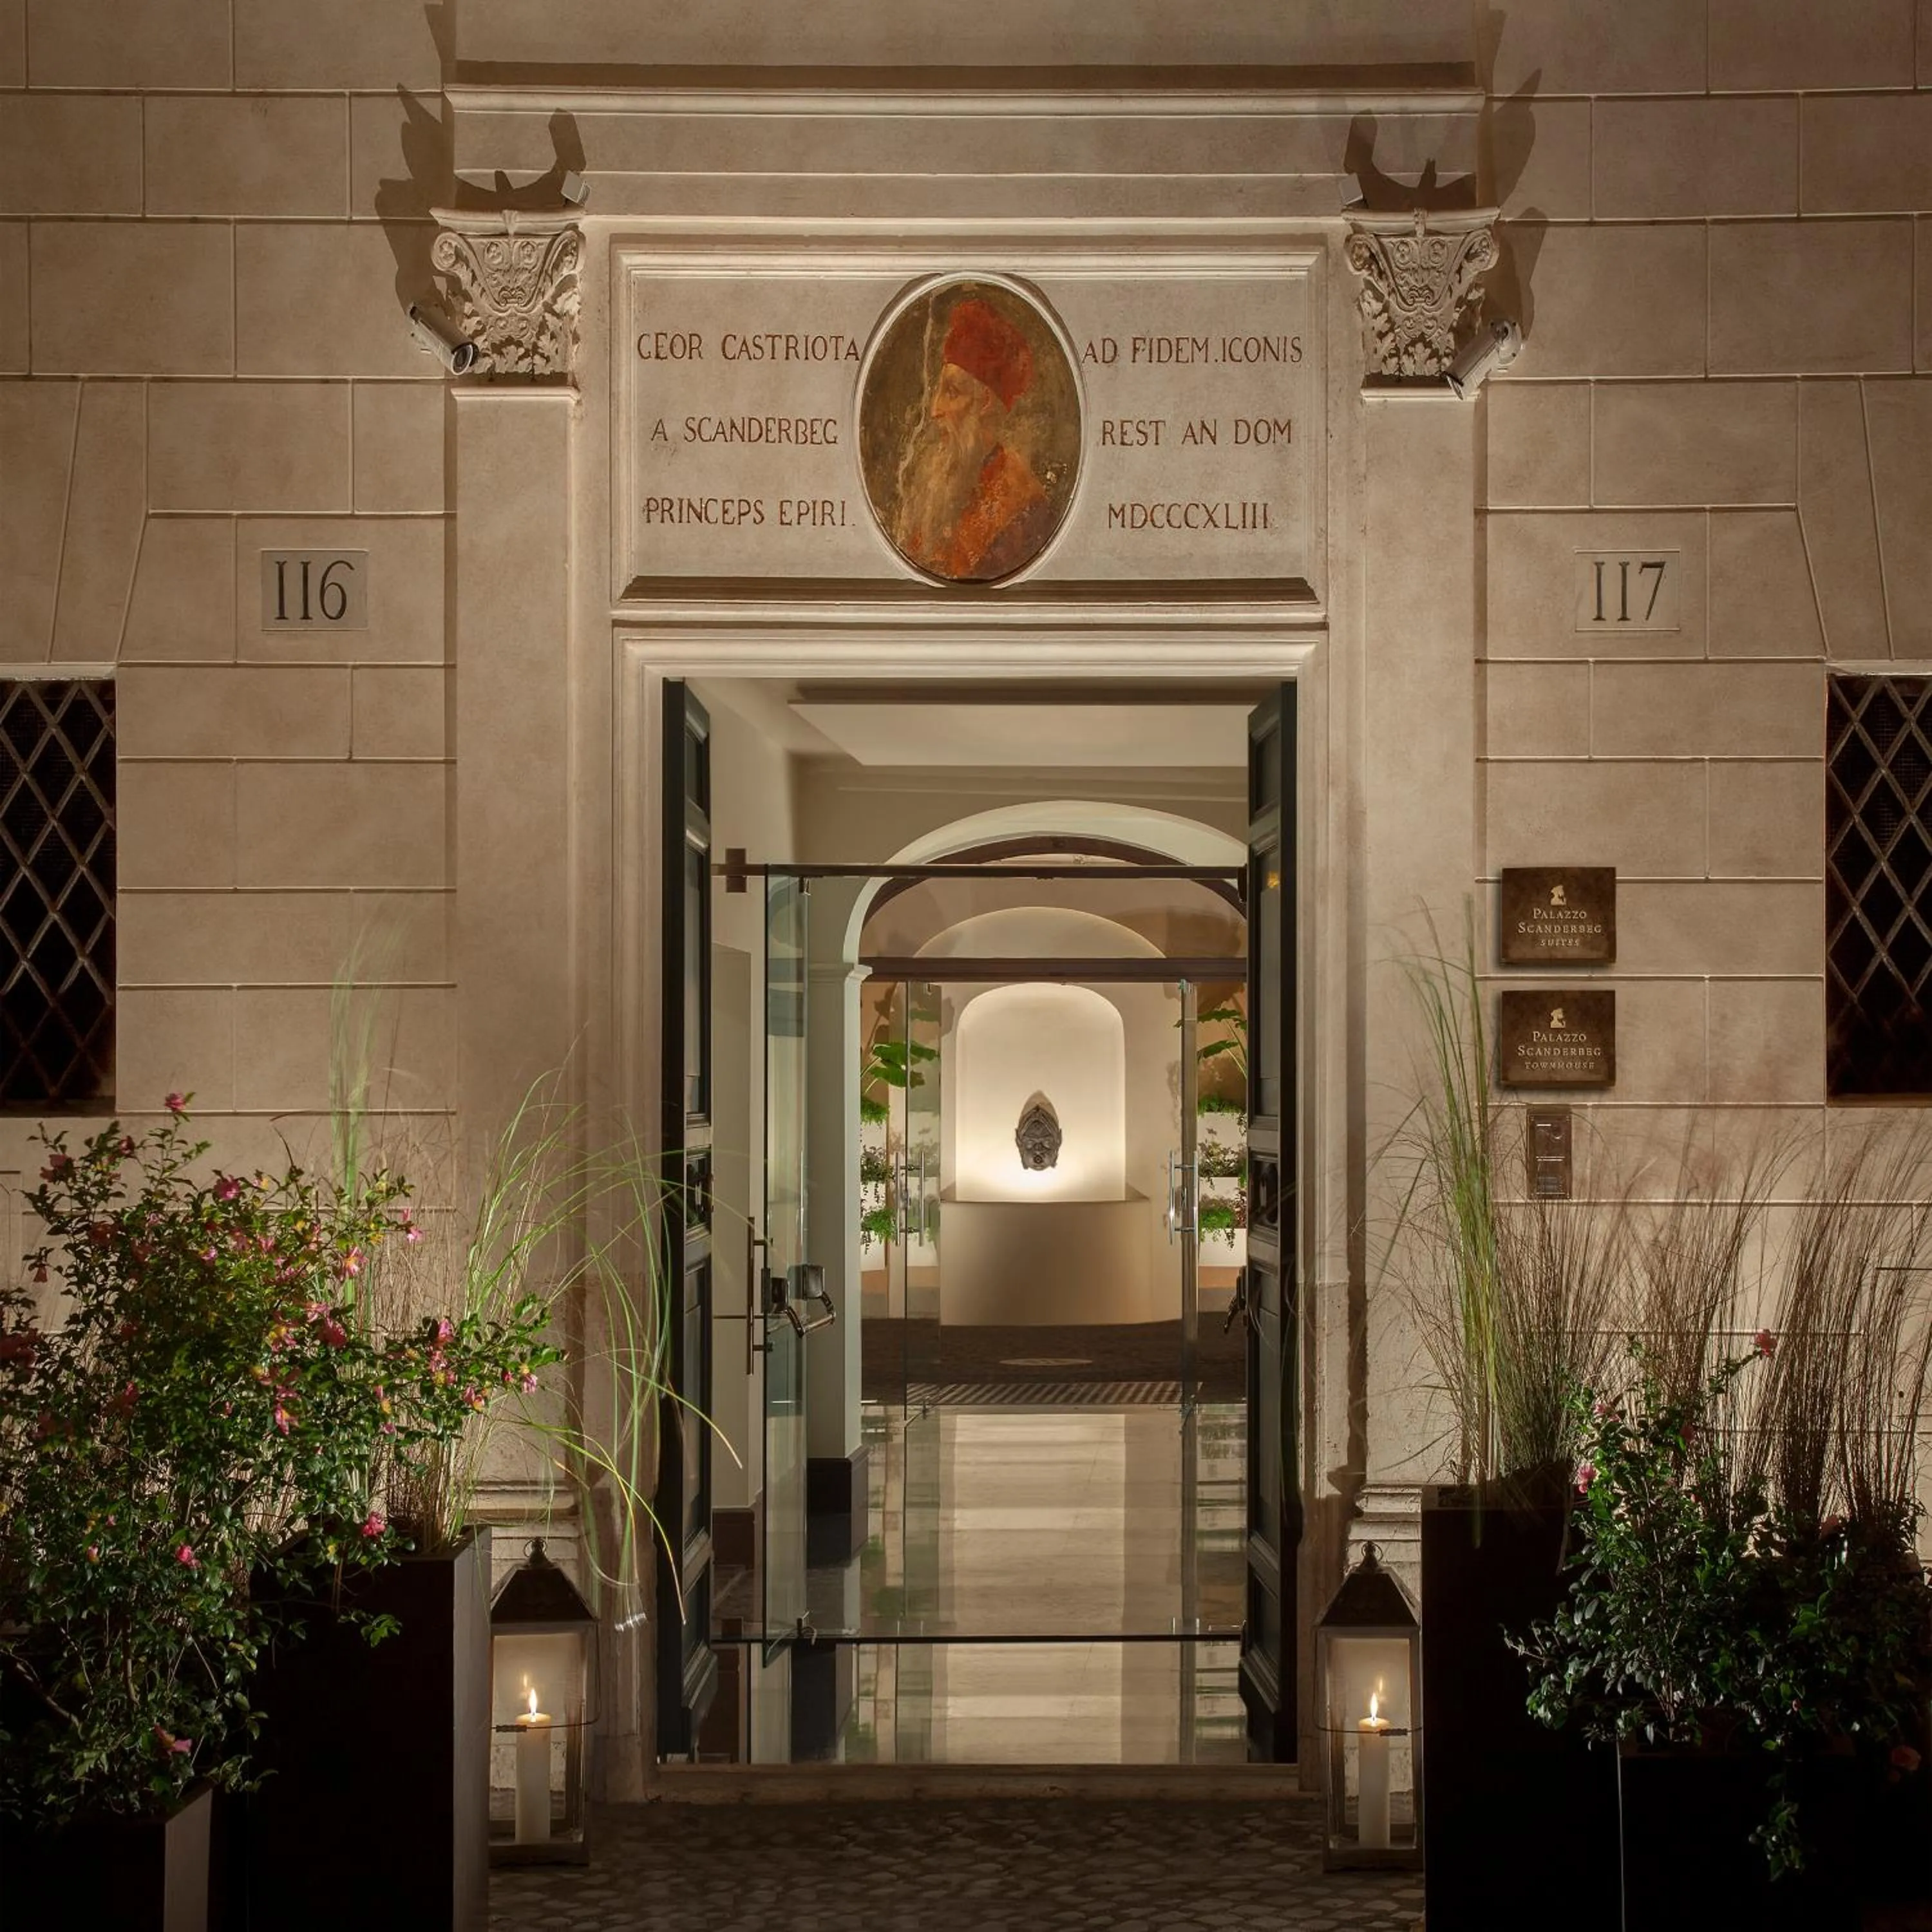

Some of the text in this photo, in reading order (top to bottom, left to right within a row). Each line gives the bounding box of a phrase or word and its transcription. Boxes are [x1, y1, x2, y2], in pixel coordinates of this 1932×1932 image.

[638, 332, 860, 361] GEOR CASTRIOTA
[1082, 337, 1118, 364] AD
[651, 417, 838, 445] A SCANDERBEG
[1102, 419, 1292, 446] REST AN DOM
[645, 497, 856, 526] PRINCEPS EPIRI.
[1108, 502, 1269, 529] MDCCCXLIII
[274, 560, 355, 620] 116
[1592, 561, 1666, 621] 117
[1533, 907, 1587, 919] PALAZZO
[1518, 922, 1602, 933] SCANDERBEG
[1540, 938, 1580, 947] SUITES
[1533, 1031, 1587, 1042] PALAZZO
[1517, 1045, 1601, 1056] SCANDERBEG
